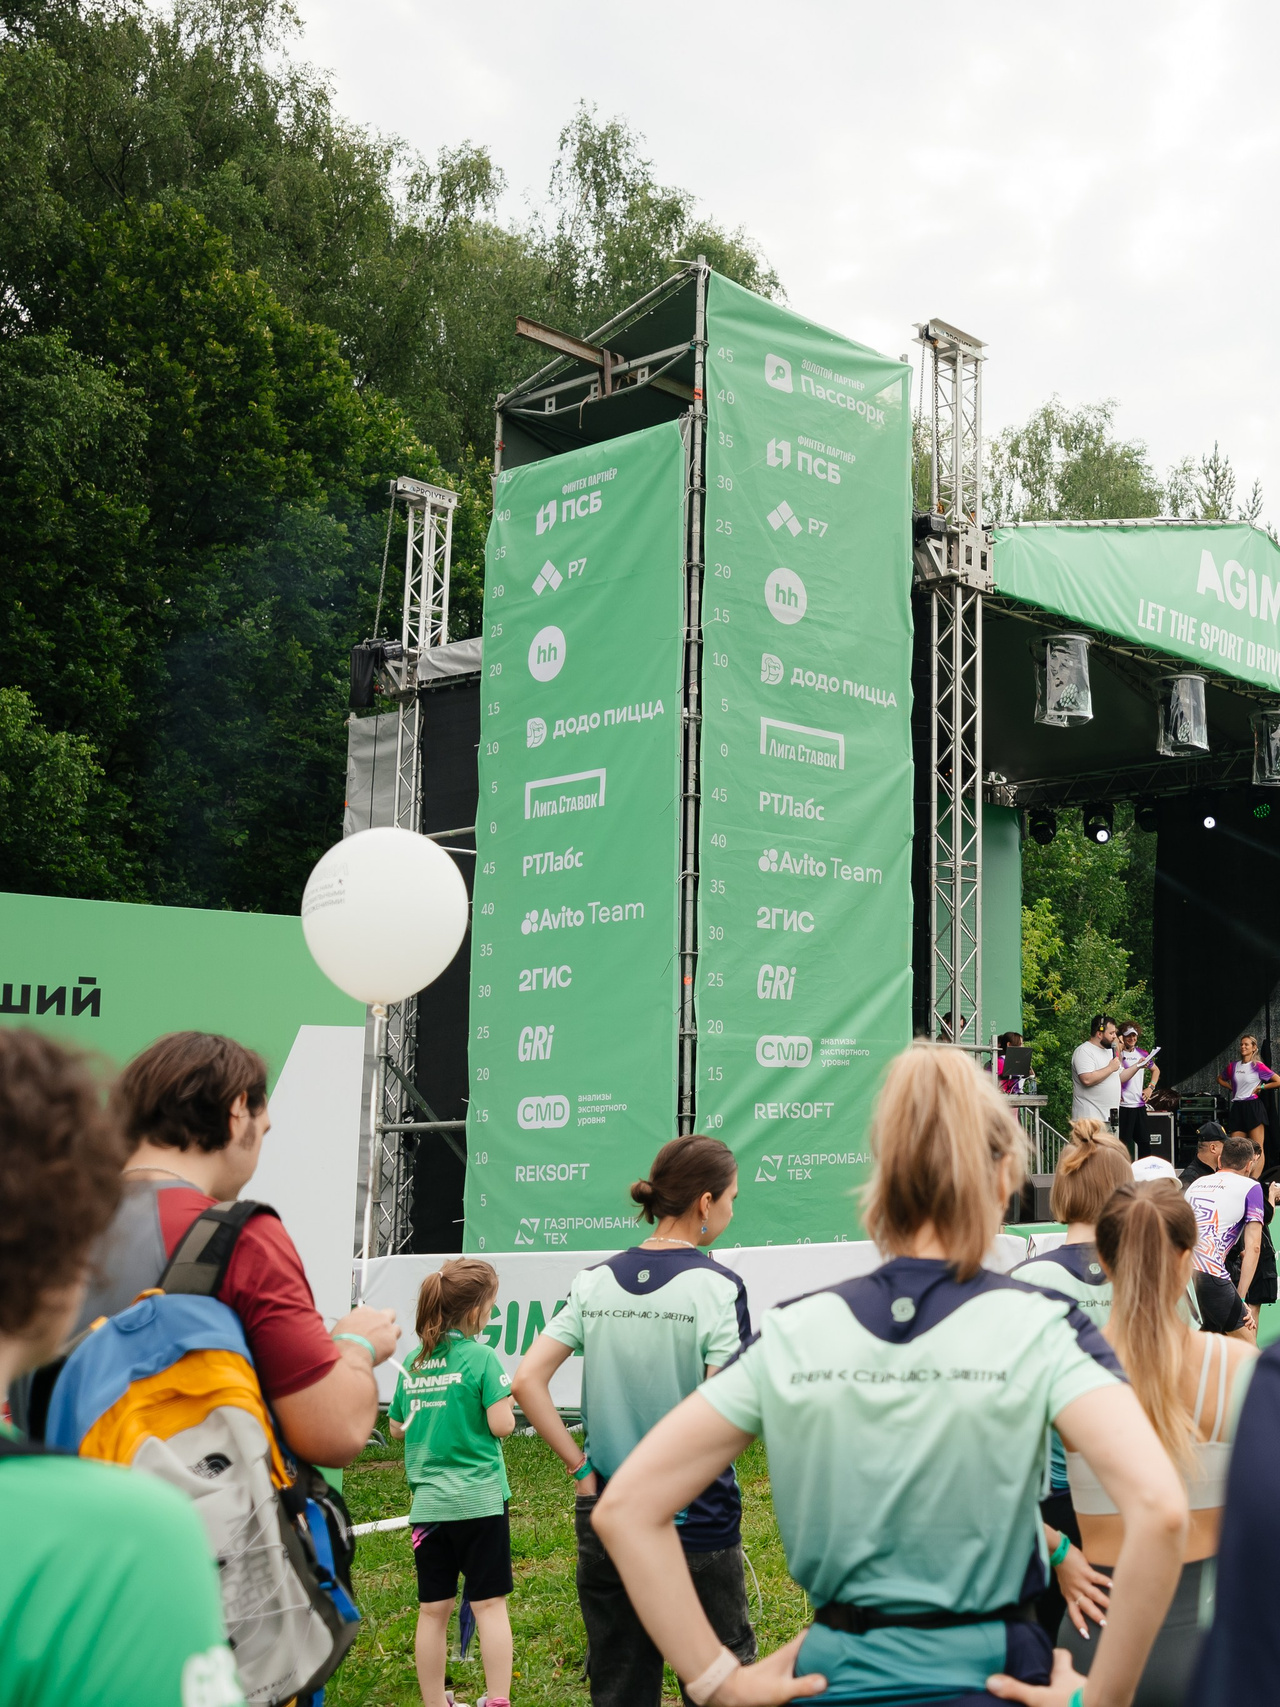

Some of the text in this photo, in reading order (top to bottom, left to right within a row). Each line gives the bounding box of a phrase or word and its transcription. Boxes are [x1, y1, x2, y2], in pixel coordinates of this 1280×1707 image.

[717, 347, 734, 363] 45
[801, 360, 866, 392] ЗОЛОТОЙ ПАРТНЁР
[717, 389, 735, 405] 40
[800, 374, 886, 426] Пассворк
[718, 431, 734, 448] 35
[798, 435, 856, 464] ФИНТЕХ ПАРТНЁР
[797, 450, 841, 484] ПСБ
[562, 468, 618, 496] ФИНТЕХ ПАРТНЁР
[716, 474, 733, 491] 30
[562, 490, 602, 523] ПСБ
[496, 508, 511, 522] 40
[716, 519, 732, 535] 25
[494, 546, 506, 561] 35
[714, 563, 732, 579] 20
[492, 584, 504, 599] 30
[775, 583, 798, 608] hh
[713, 608, 730, 624] 15
[490, 624, 503, 638] 25
[1138, 598, 1166, 634] LET
[1170, 609, 1198, 646] THE
[1200, 622, 1244, 663] SPORT
[536, 643, 558, 664] hh
[712, 652, 729, 668] 10
[490, 662, 502, 678] 20
[790, 668, 897, 708] ДОДО ПИЦЦА
[488, 702, 500, 716] 15
[721, 698, 729, 712] 5
[552, 700, 664, 740] ДОДО ПИЦЦА
[486, 742, 500, 756] 10
[720, 744, 728, 758] 0
[491, 781, 498, 794] 5
[711, 787, 728, 803] 45
[759, 791, 825, 821] РТЛабс
[490, 822, 498, 834] 0
[710, 833, 727, 848] 40
[482, 861, 496, 875] 45
[523, 846, 584, 877] РТЛабс
[778, 851, 883, 884] Avito Team
[710, 880, 726, 895] 35
[481, 902, 494, 916] 40
[538, 902, 644, 932] Avito Team
[756, 906, 815, 933] 2ГИС
[708, 926, 724, 940] 30
[480, 943, 493, 956] 35
[518, 964, 572, 992] 2ГИС
[707, 972, 724, 987] 25
[478, 984, 492, 998] 30
[476, 1026, 490, 1040] 25
[707, 1020, 724, 1034] 20
[820, 1038, 856, 1046] анализы
[761, 1042, 809, 1061] CMD
[820, 1048, 870, 1057] экспертного
[821, 1058, 850, 1068] уровня
[476, 1067, 490, 1081] 20
[708, 1066, 723, 1081] 15
[578, 1093, 612, 1102] анализы
[522, 1102, 566, 1122] CMD
[578, 1103, 628, 1114] экспертного
[754, 1102, 835, 1120] REKSOFT
[476, 1110, 489, 1123] 15
[578, 1116, 606, 1126] уровня
[706, 1114, 724, 1129] 10
[475, 1152, 488, 1165] 10
[787, 1152, 872, 1166] ГАЗПРОМБАН
[516, 1164, 590, 1182] REKSOFT
[787, 1168, 812, 1180] ТЕХ
[480, 1194, 487, 1207] 5
[544, 1216, 640, 1230] ГАЗПРОМБАНК
[478, 1236, 486, 1250] 0
[544, 1232, 568, 1245] ТЕХ
[612, 1309, 653, 1319] СЕЙЧАС
[662, 1312, 694, 1324] ЗАВТРА
